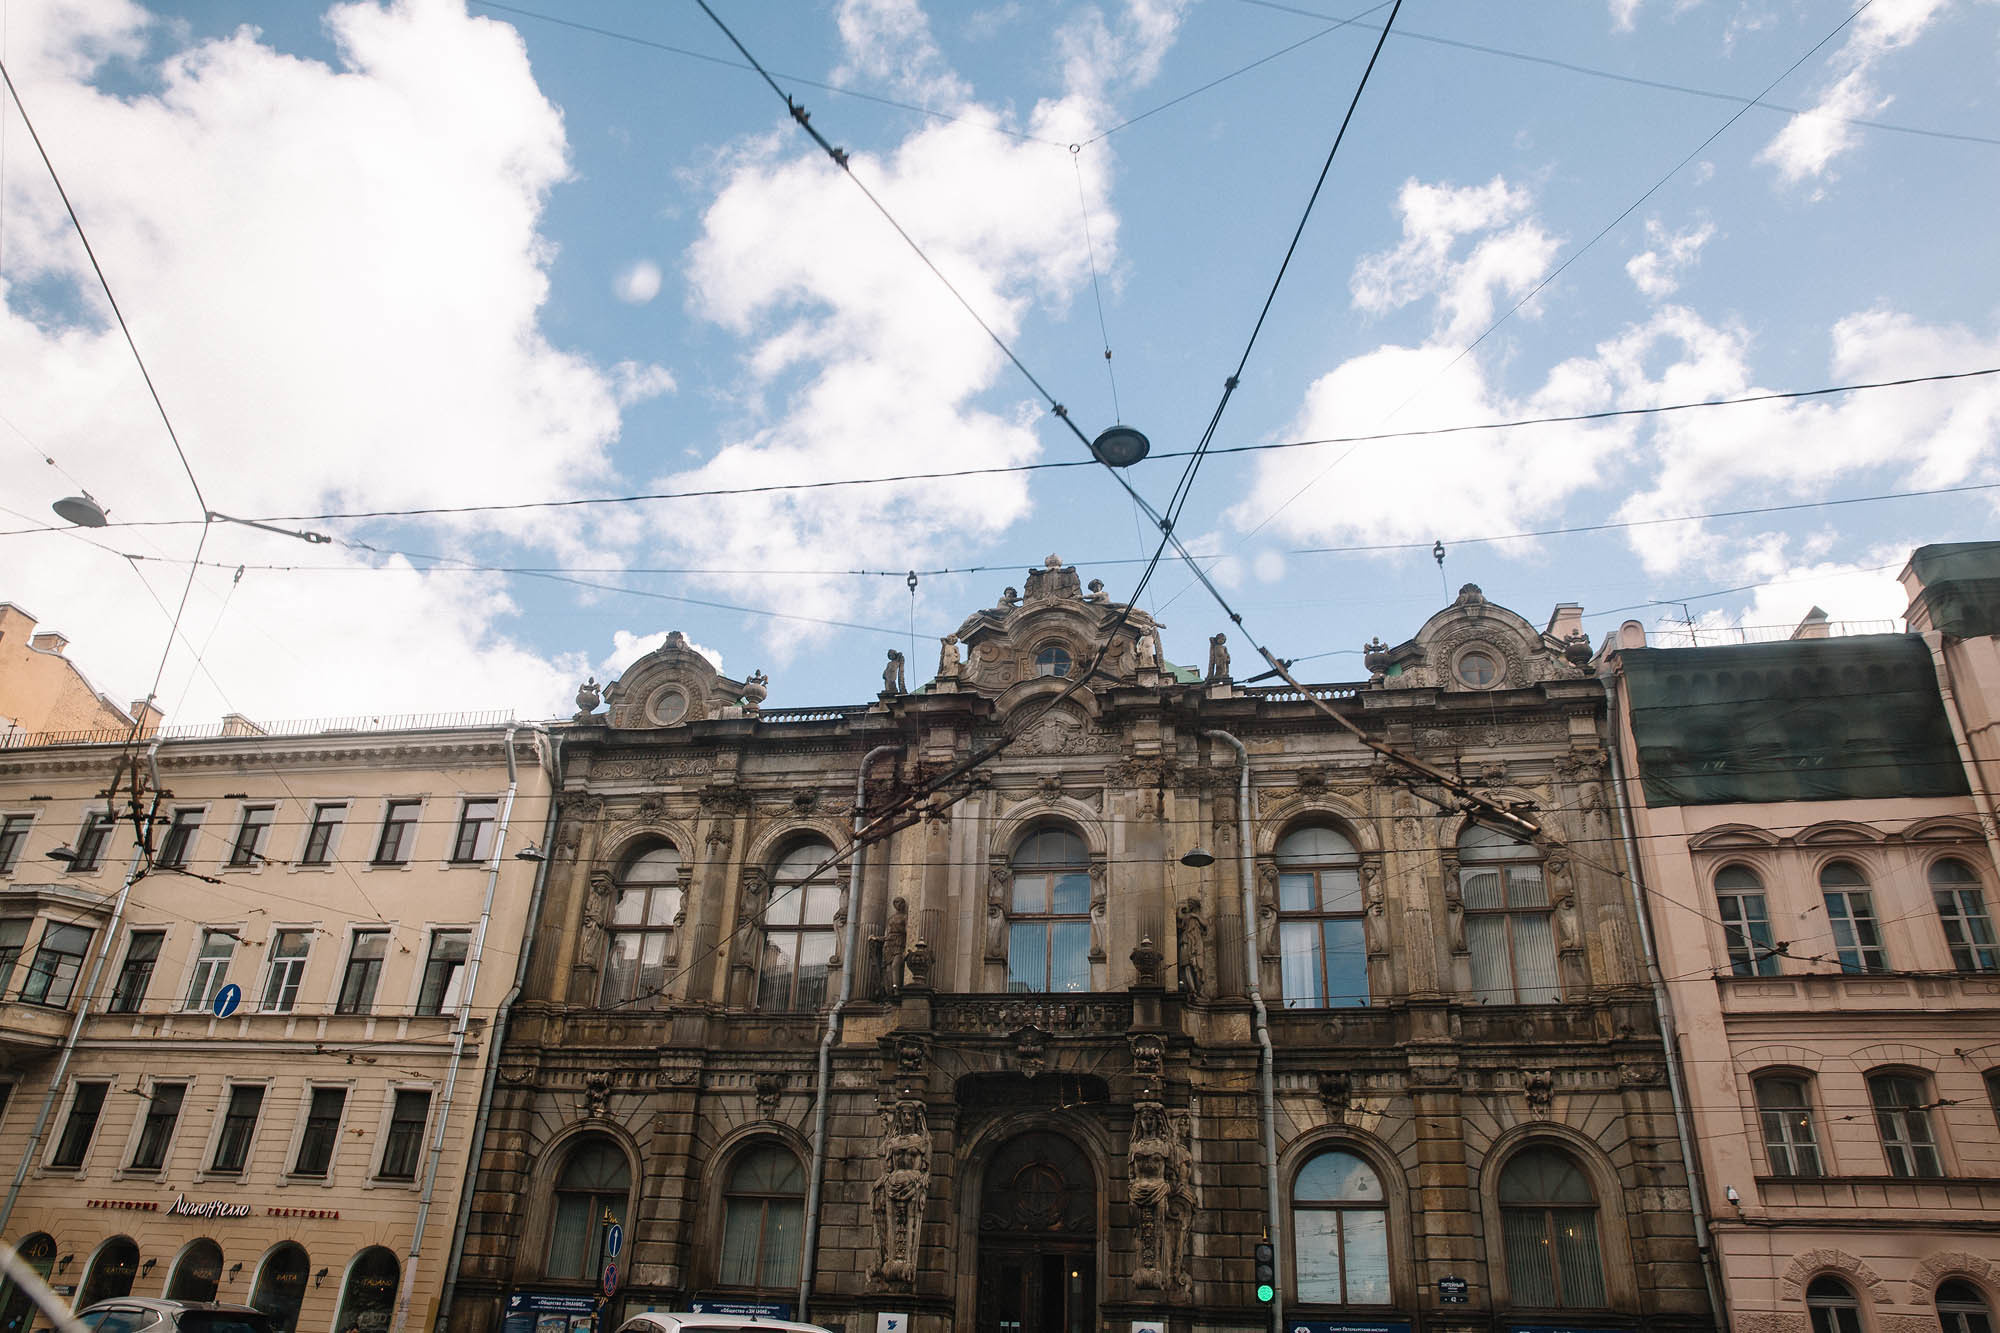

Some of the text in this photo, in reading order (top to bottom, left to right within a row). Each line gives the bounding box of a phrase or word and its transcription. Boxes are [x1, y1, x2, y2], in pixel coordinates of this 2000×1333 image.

[86, 1192, 251, 1218] ТРАТТОРИЯ Лимончелло
[267, 1208, 339, 1219] TRATTORIA
